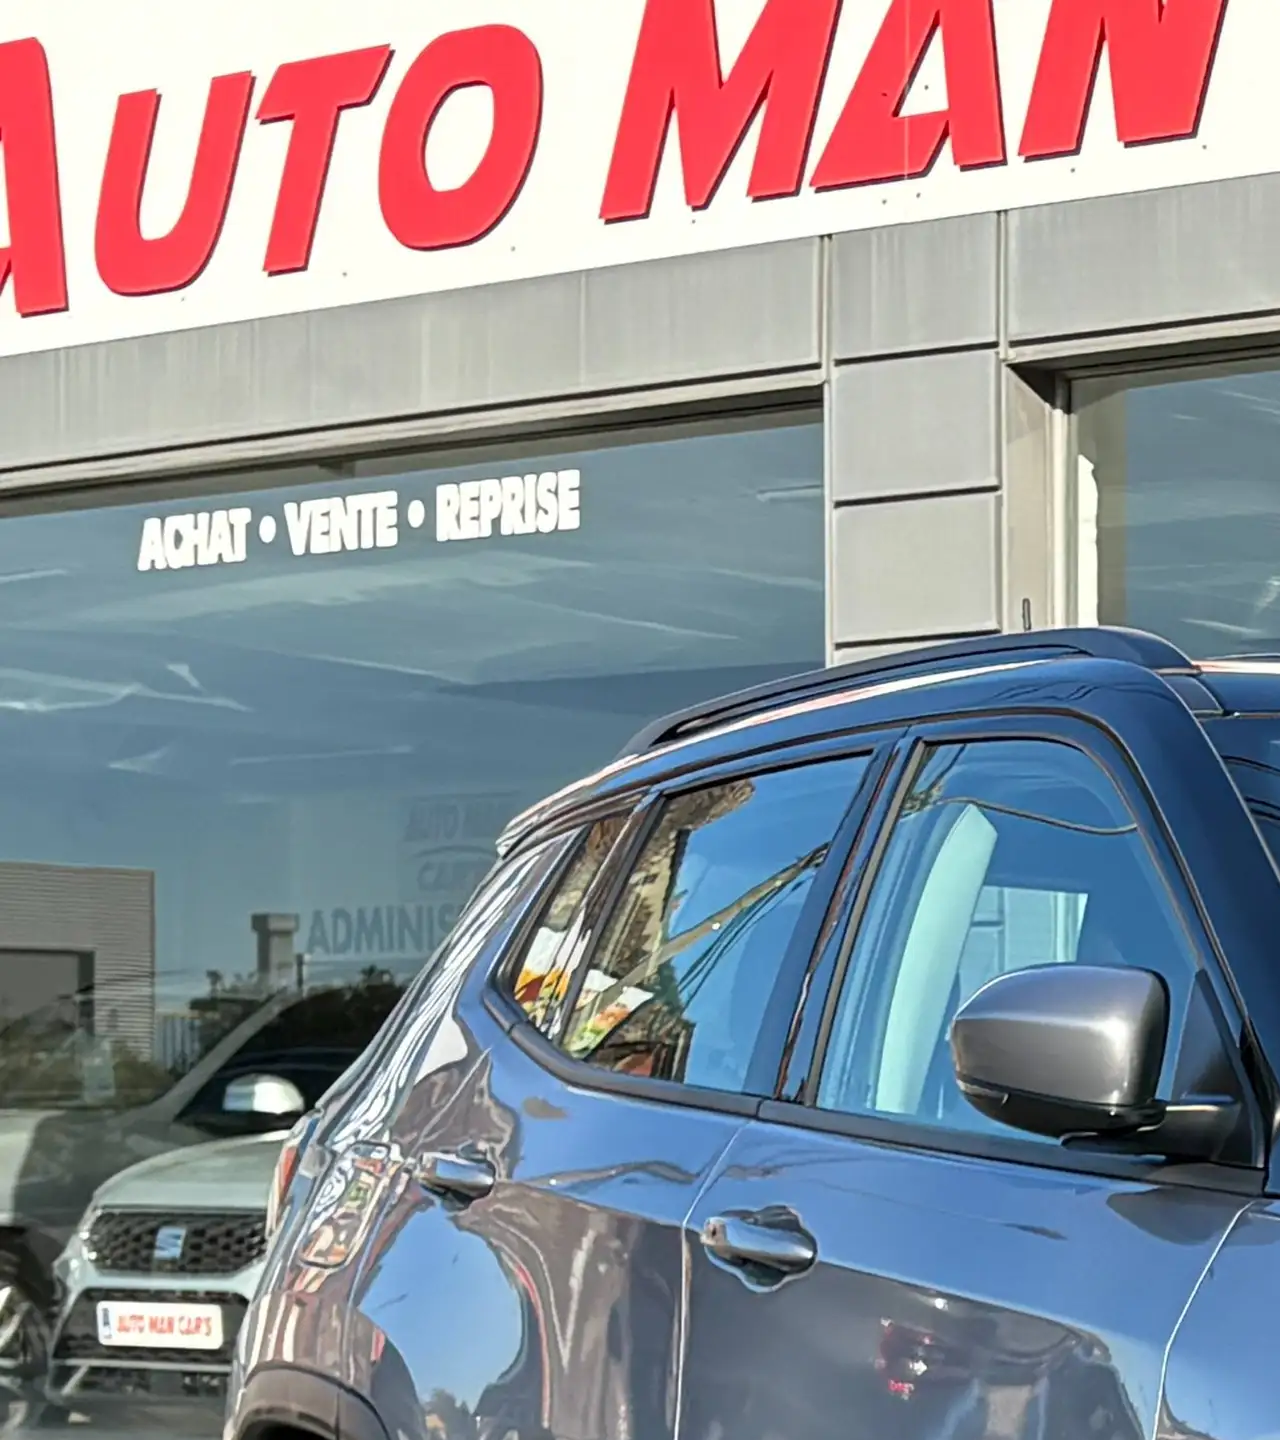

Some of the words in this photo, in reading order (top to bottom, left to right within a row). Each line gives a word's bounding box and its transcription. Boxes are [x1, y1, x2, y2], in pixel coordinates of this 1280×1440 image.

[598, 0, 1229, 223] MAN
[138, 507, 251, 571] ACHAT
[284, 491, 398, 556] VENTE
[436, 470, 581, 542] REPRISE
